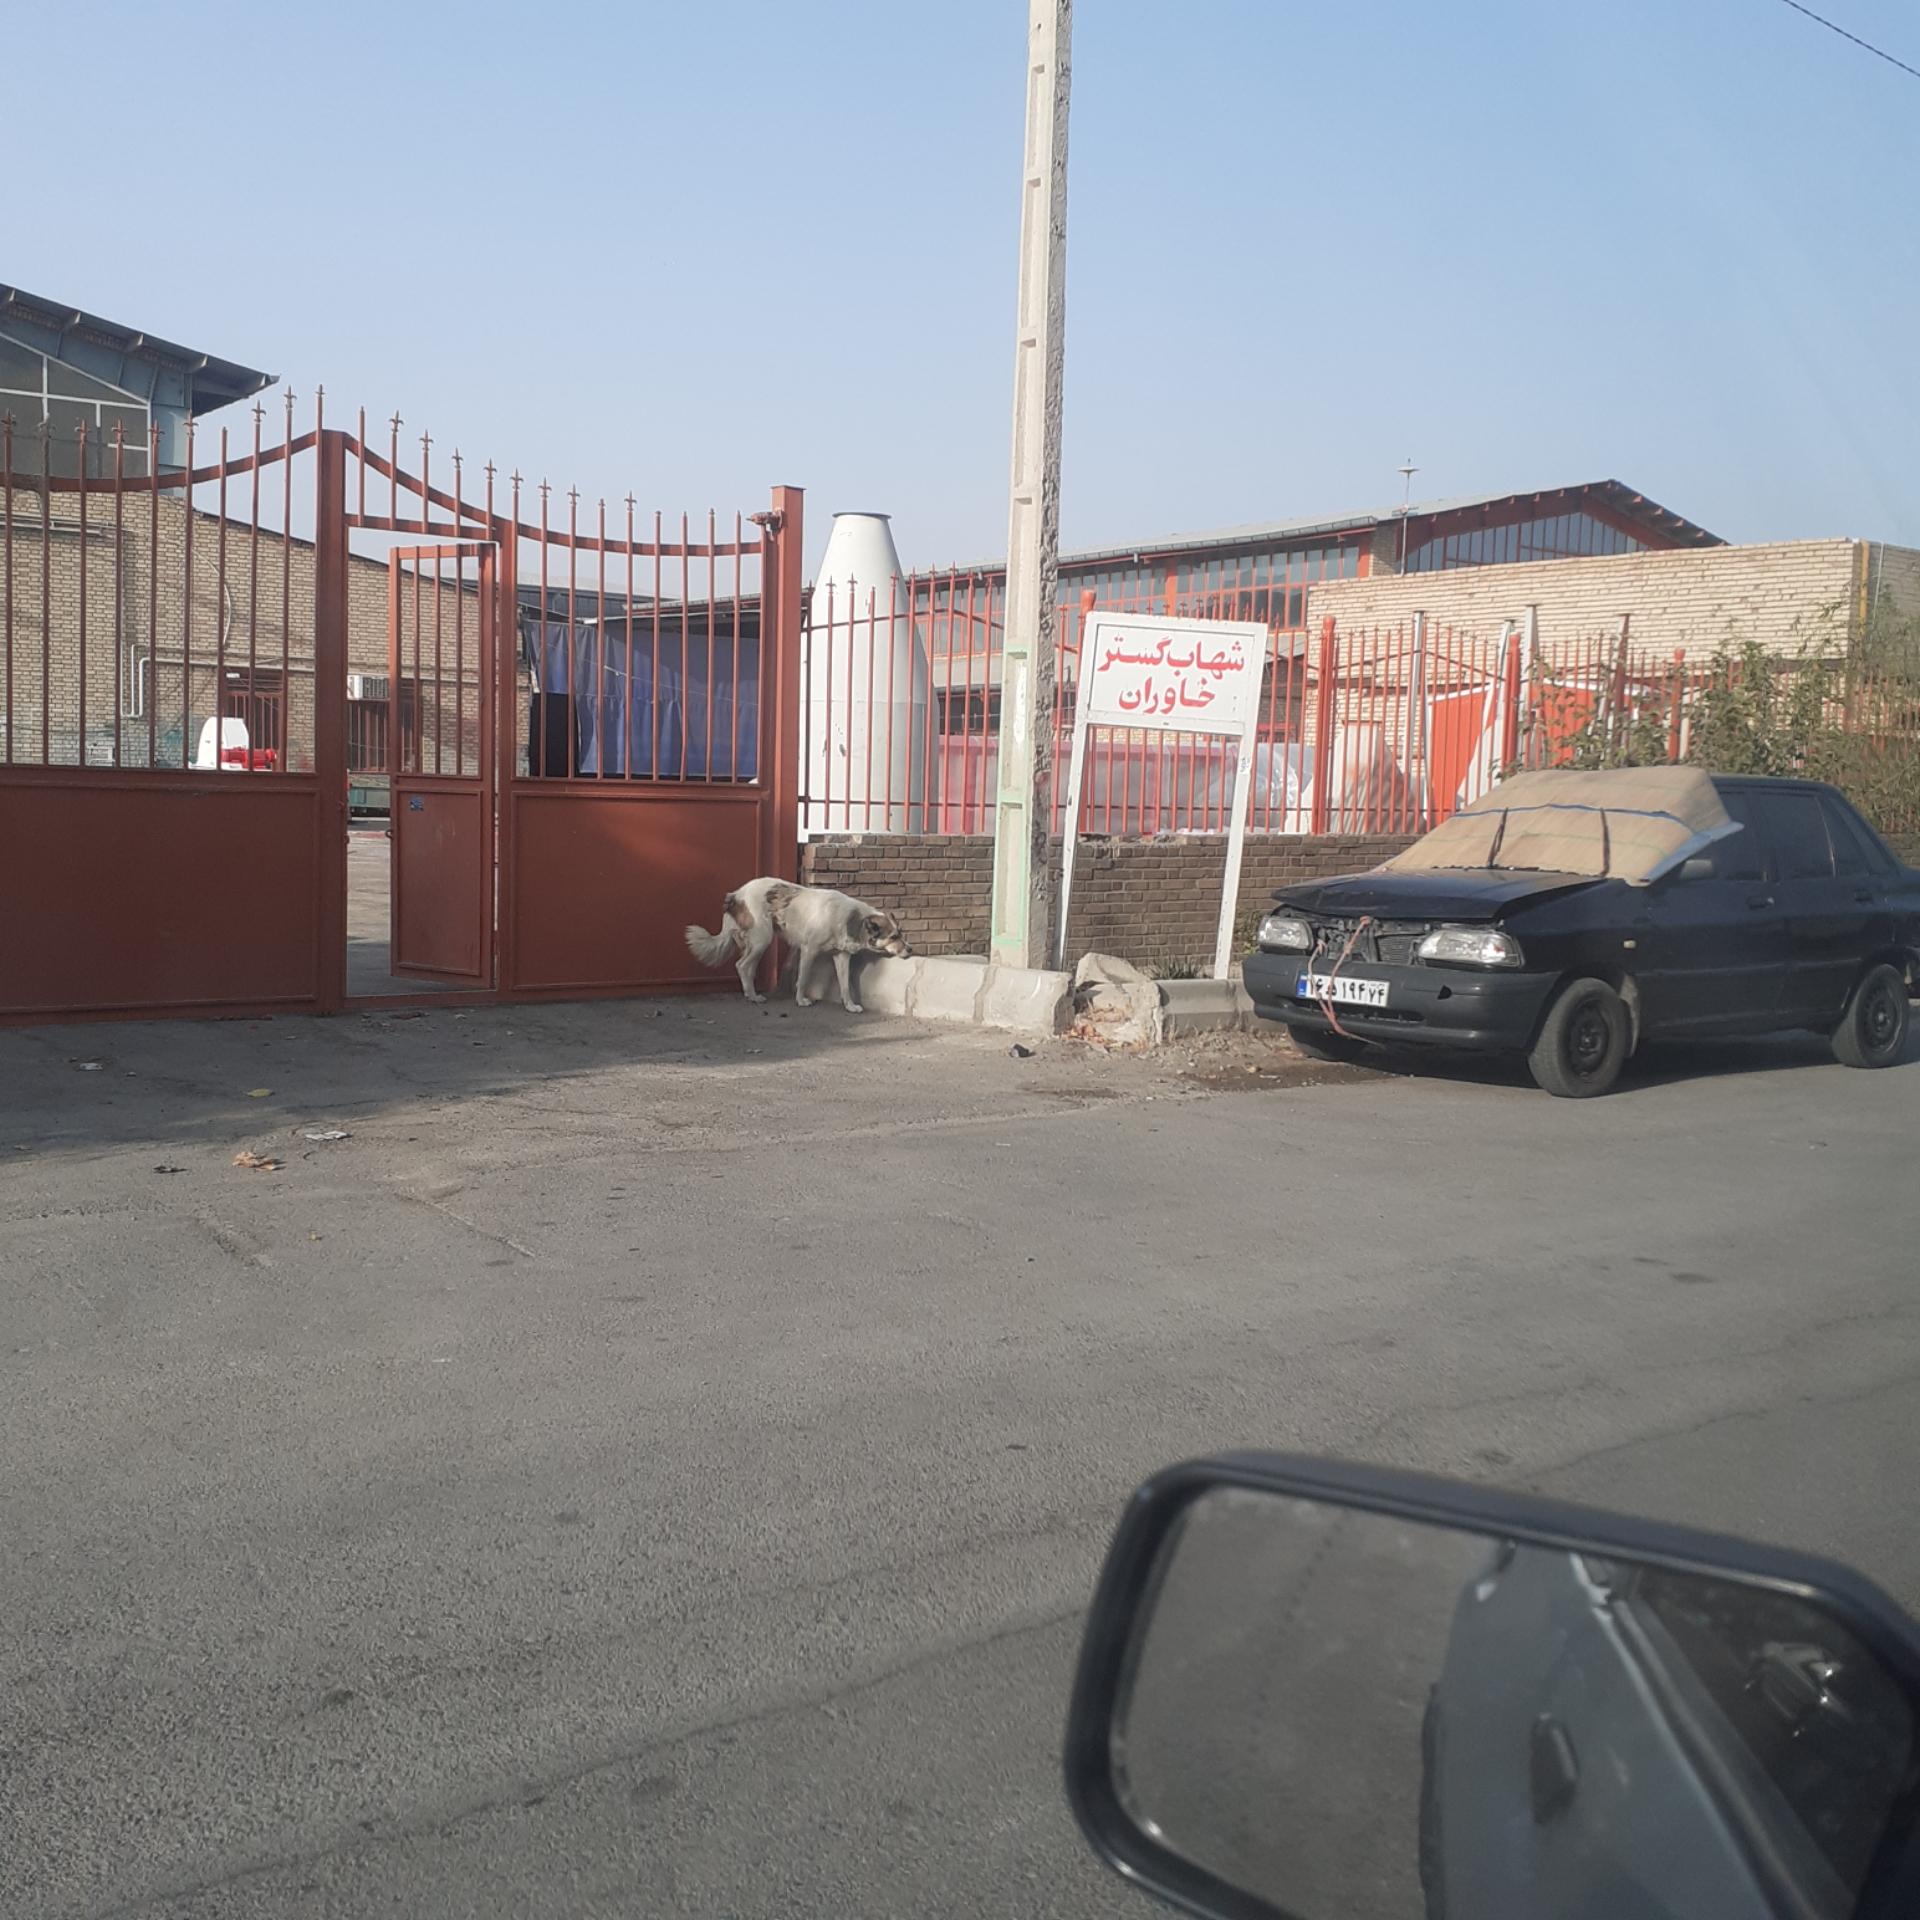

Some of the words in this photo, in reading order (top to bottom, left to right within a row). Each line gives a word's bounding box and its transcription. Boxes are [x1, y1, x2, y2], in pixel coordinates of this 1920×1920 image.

[1097, 635, 1172, 672] گستر
[1166, 640, 1245, 680] شهاب
[1118, 676, 1216, 715] خاوران
